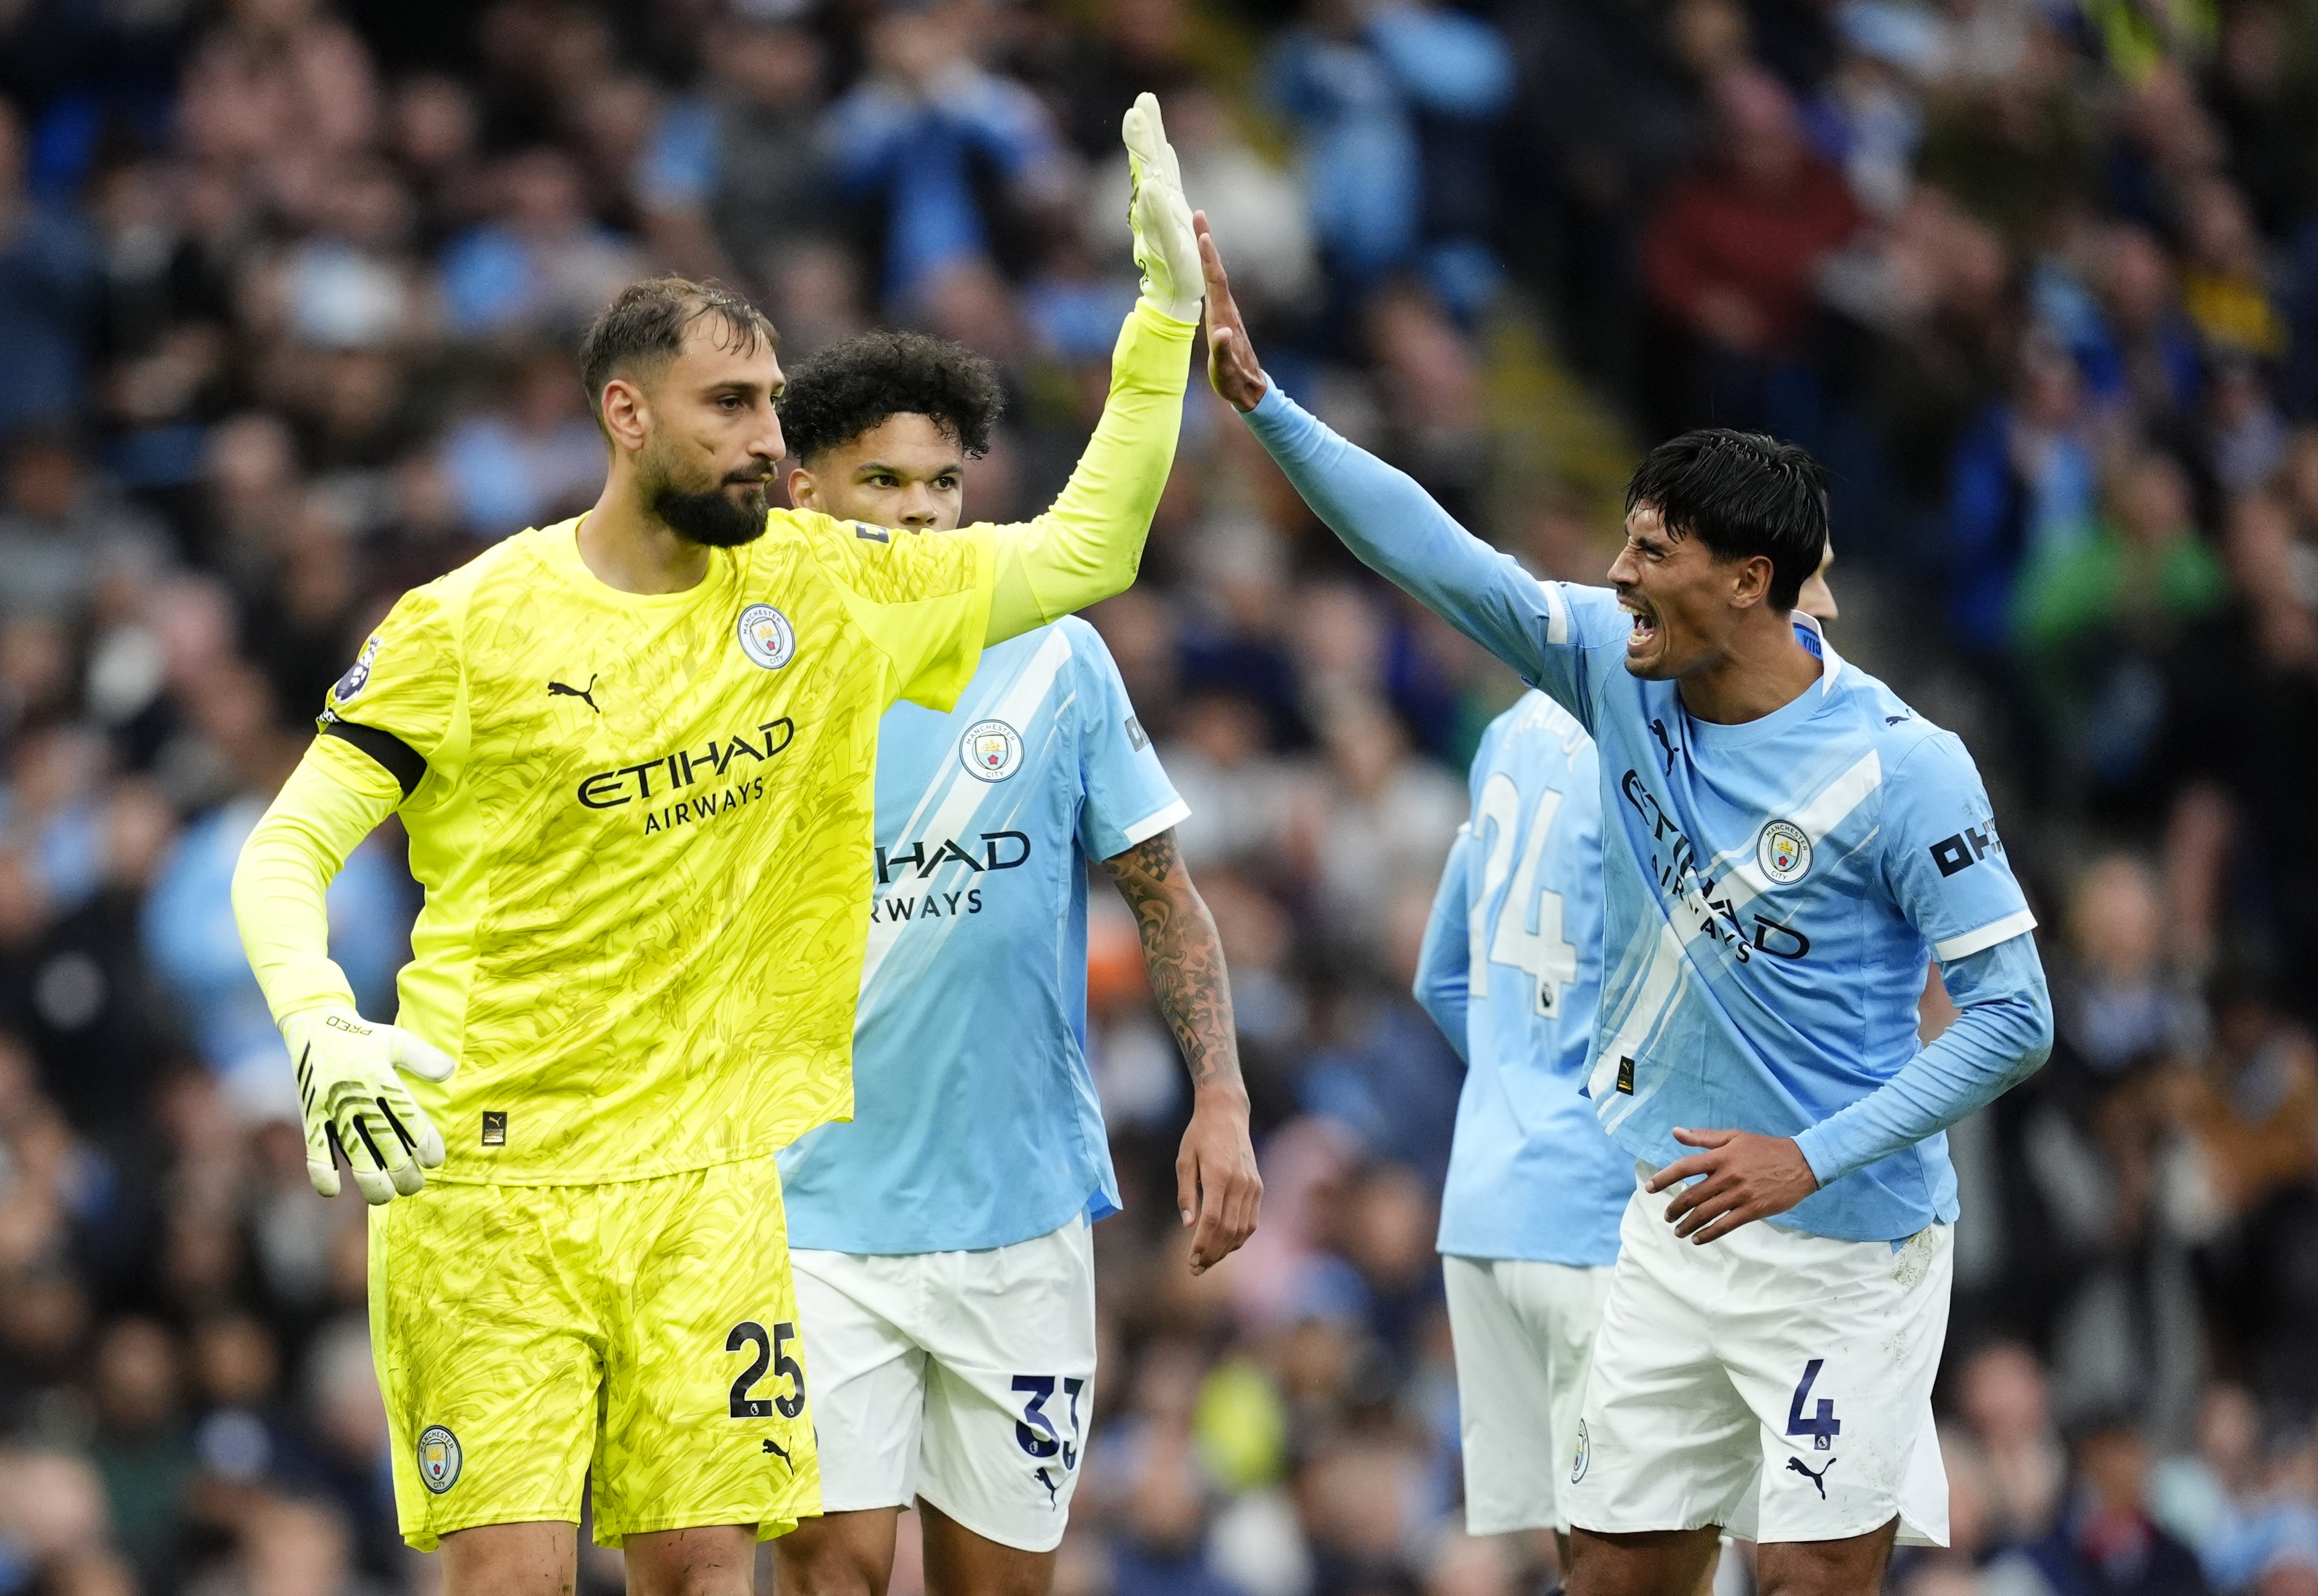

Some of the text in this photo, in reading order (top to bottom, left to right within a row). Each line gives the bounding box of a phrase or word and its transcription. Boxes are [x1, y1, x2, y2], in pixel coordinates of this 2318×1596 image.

[743, 610, 781, 634] MANCHESTER
[769, 655, 783, 664] CITY
[966, 725, 1016, 744] MANCHESTER
[578, 717, 795, 809] ETIHAD
[645, 777, 764, 835] AIRWAYS
[1766, 825, 1808, 851] MANCHESTER
[875, 831, 1031, 884] HAD
[1771, 871, 1788, 880] CITY
[870, 889, 982, 923] RWAYS
[1469, 772, 1577, 1019] 24
[326, 1016, 373, 1036] PRED
[726, 1322, 805, 1418] 25
[1785, 1359, 1841, 1450] 4
[1012, 1375, 1084, 1470] 33
[420, 1431, 454, 1453] MANCHESTER
